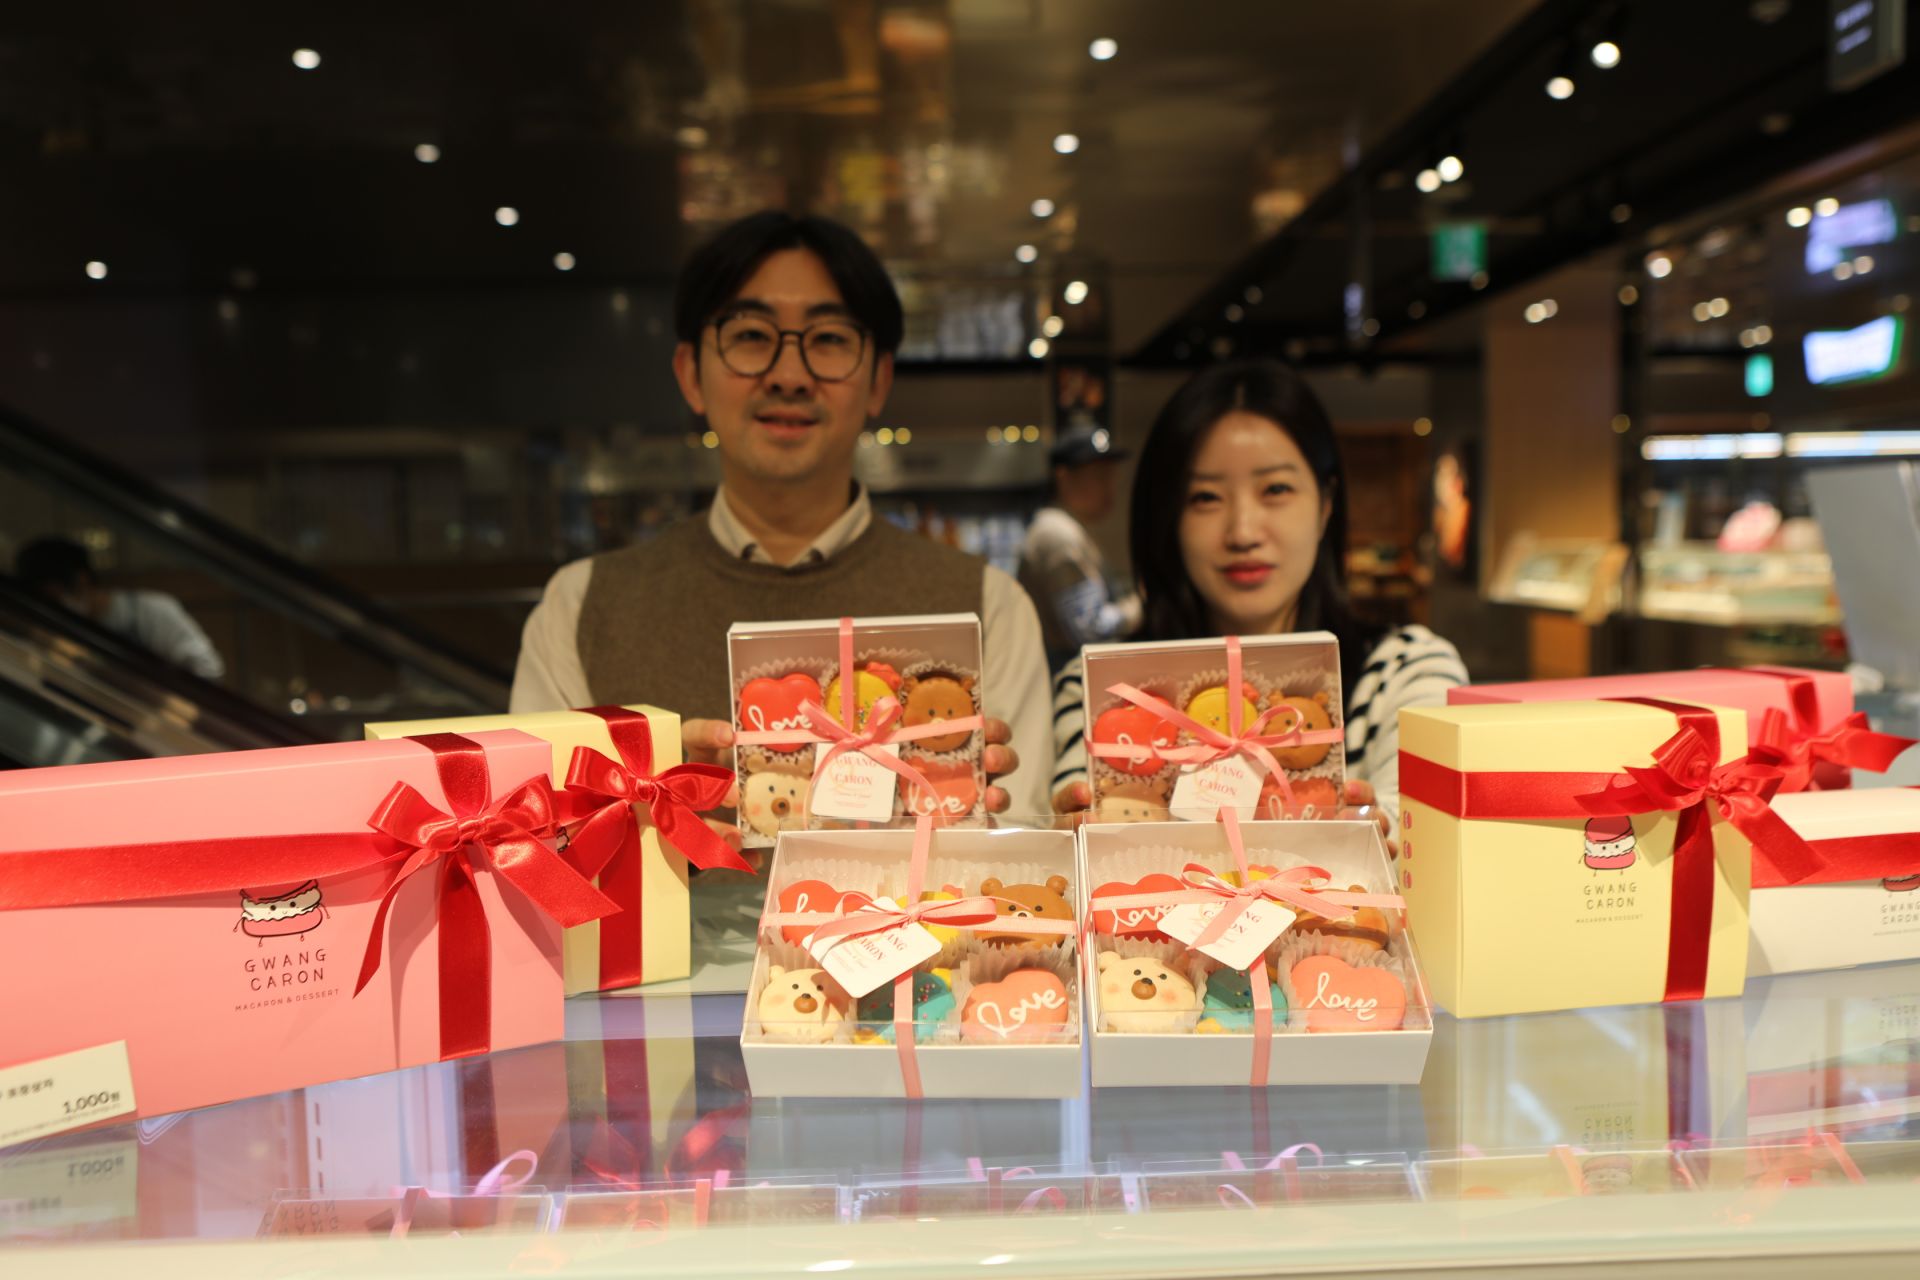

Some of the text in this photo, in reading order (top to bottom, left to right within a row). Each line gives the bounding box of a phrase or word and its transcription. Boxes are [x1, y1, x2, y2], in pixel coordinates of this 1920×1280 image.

[1583, 882, 1638, 896] GWANG
[1586, 897, 1635, 910] CARON
[244, 948, 327, 972] GWANG
[250, 967, 324, 991] CARON
[235, 997, 283, 1011] MACARON
[296, 988, 340, 1002] DESSERT
